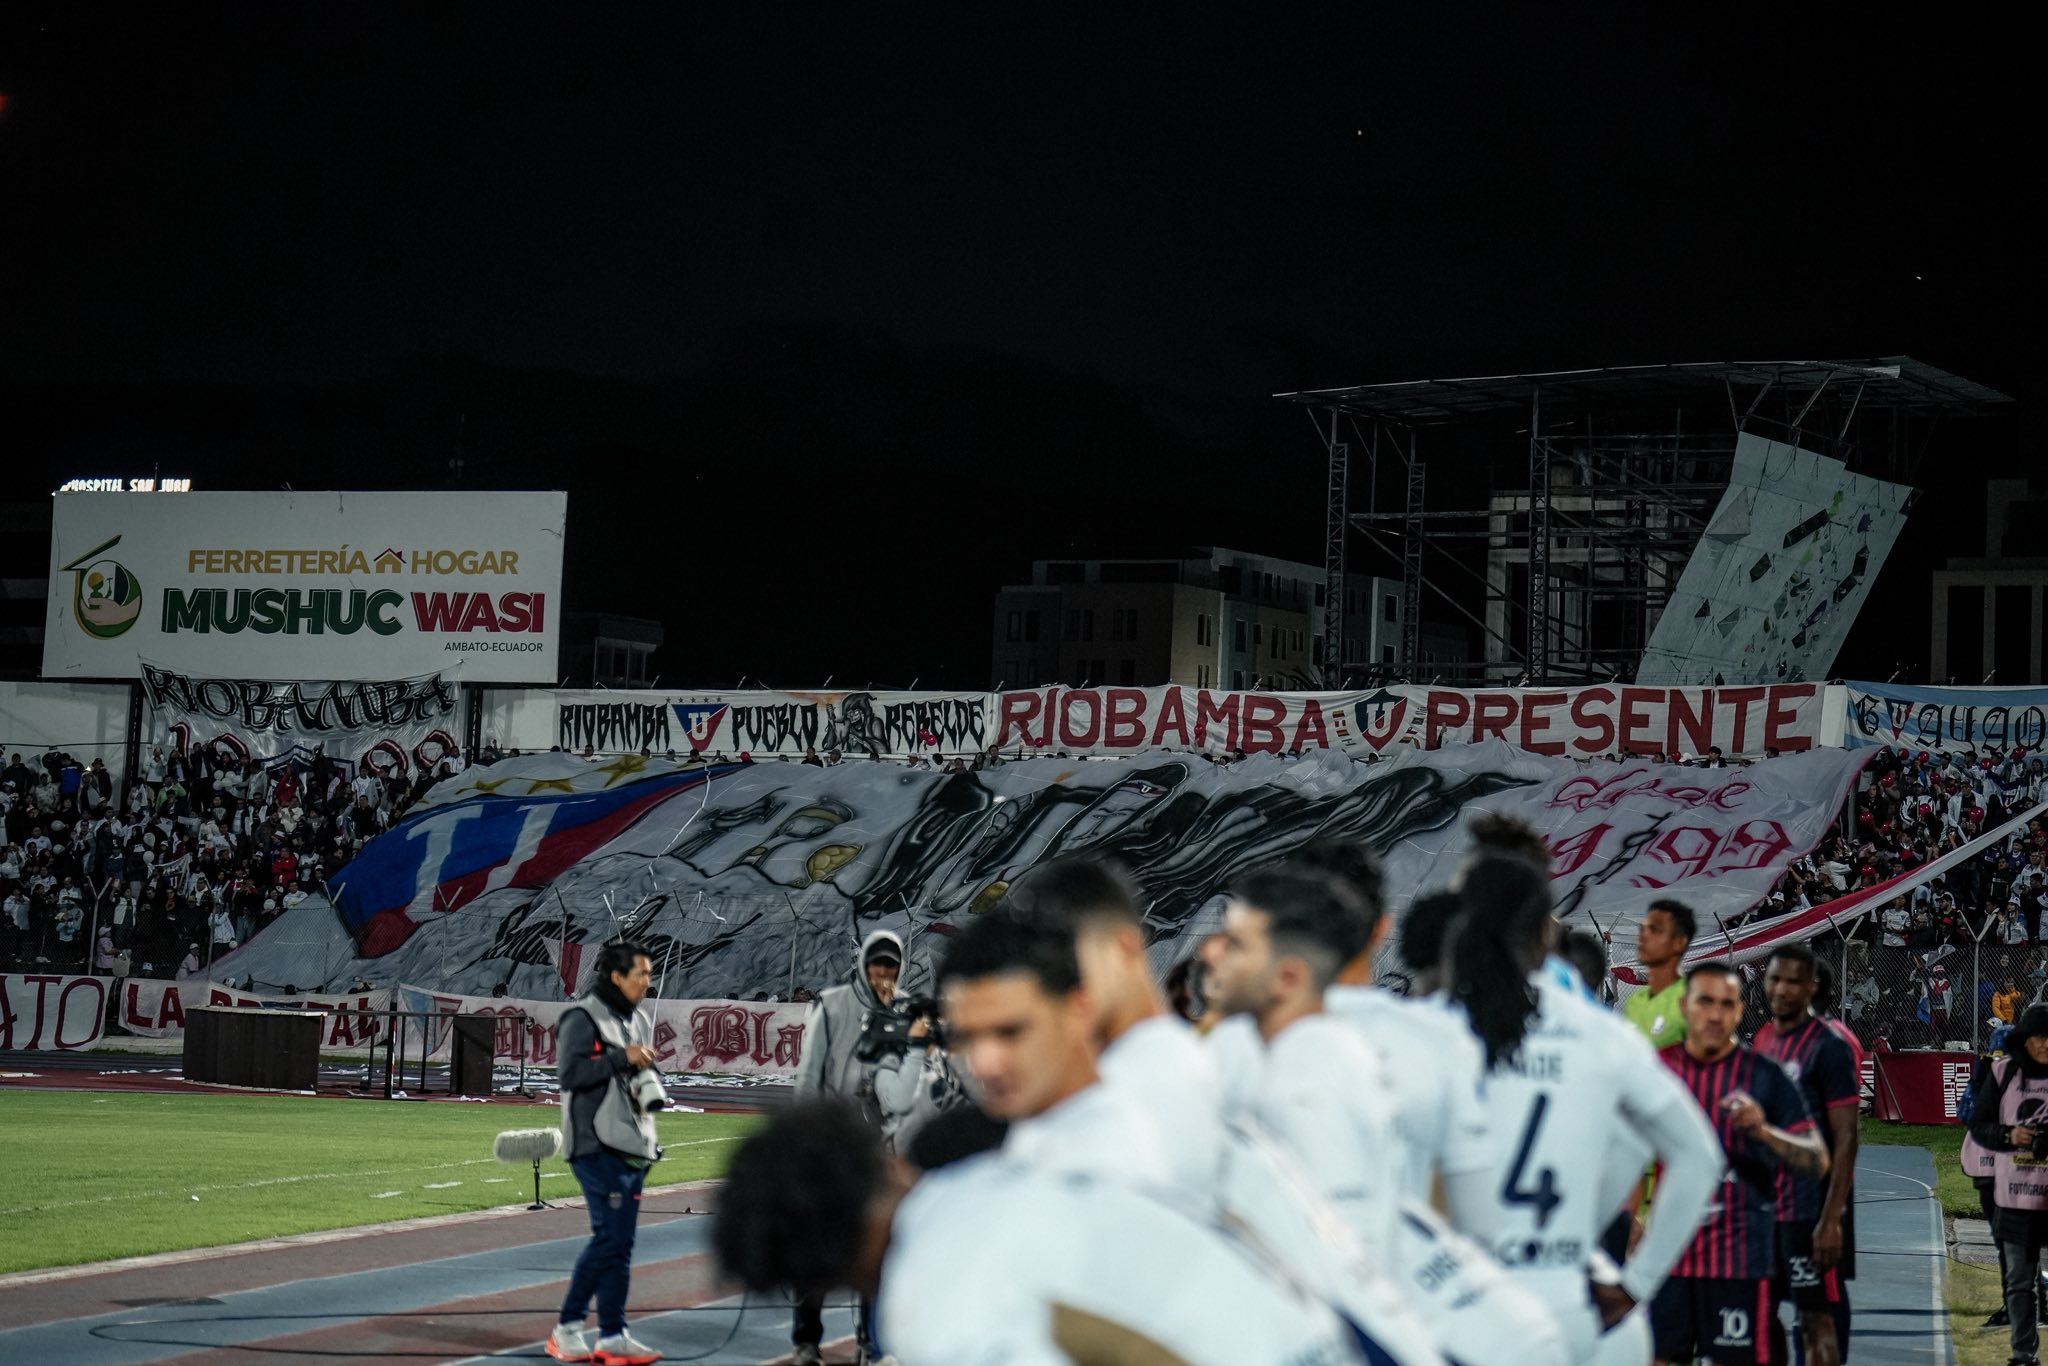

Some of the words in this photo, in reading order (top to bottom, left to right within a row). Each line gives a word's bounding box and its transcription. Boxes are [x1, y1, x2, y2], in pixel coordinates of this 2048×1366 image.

[188, 544, 370, 575] FERRETERÍA
[412, 550, 518, 576] HOGAR
[162, 588, 404, 635] MUSHUC
[411, 592, 545, 634] WASI
[444, 641, 543, 652] AMBATO-ECUADOR
[142, 662, 456, 731] RIOBAMBA
[996, 685, 1330, 755] RIOBAMBA
[1427, 684, 1817, 756] PRESENTE
[559, 704, 670, 752] RIOBAMBA
[731, 705, 820, 751] PUEBLO
[884, 700, 986, 752] REBELDE
[127, 984, 185, 1028] LA
[1502, 1092, 1561, 1229] 4
[1718, 1306, 1749, 1338] 10
